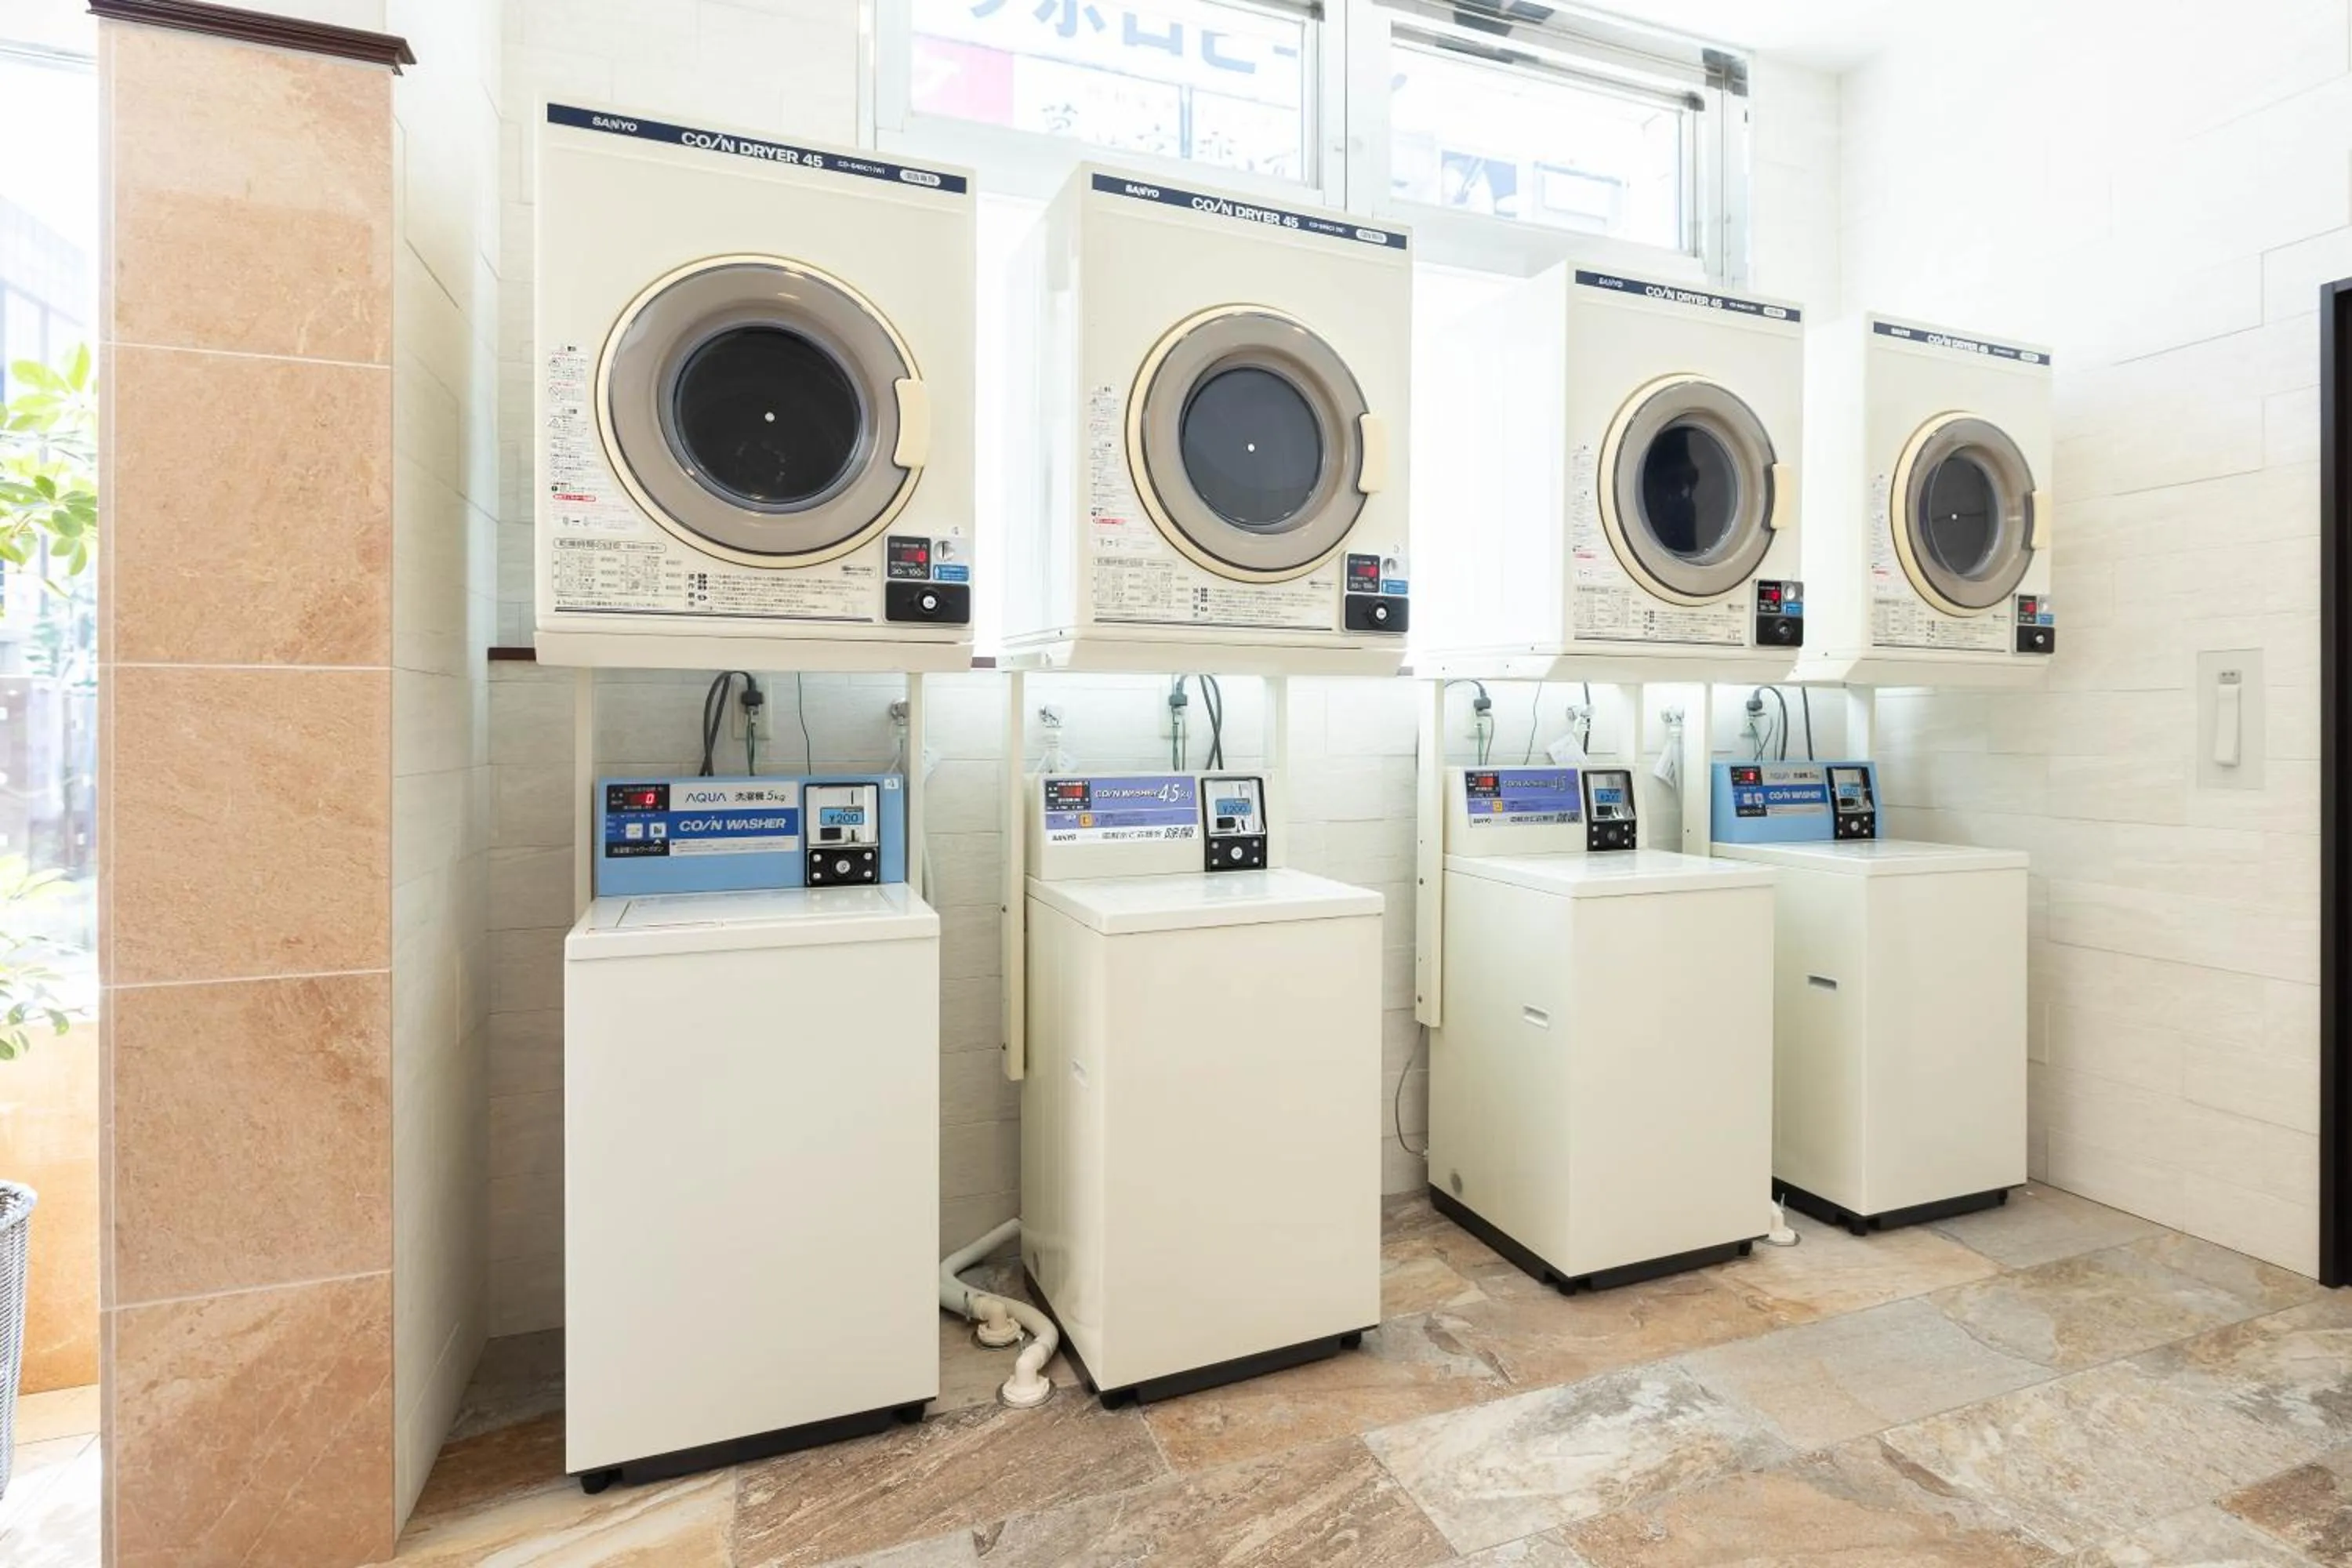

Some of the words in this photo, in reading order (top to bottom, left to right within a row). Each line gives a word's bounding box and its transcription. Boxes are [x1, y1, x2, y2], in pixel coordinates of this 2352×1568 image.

[592, 116, 637, 132] SANYO
[739, 142, 799, 164] DRYER
[802, 153, 824, 168] 45
[1125, 184, 1160, 198] SANYO
[1236, 206, 1280, 226] DRYER
[1283, 216, 1299, 229] 45
[1710, 299, 1723, 308] 45
[645, 793, 655, 804] 0
[685, 792, 727, 803] AQUA
[726, 817, 786, 831] WASHER
